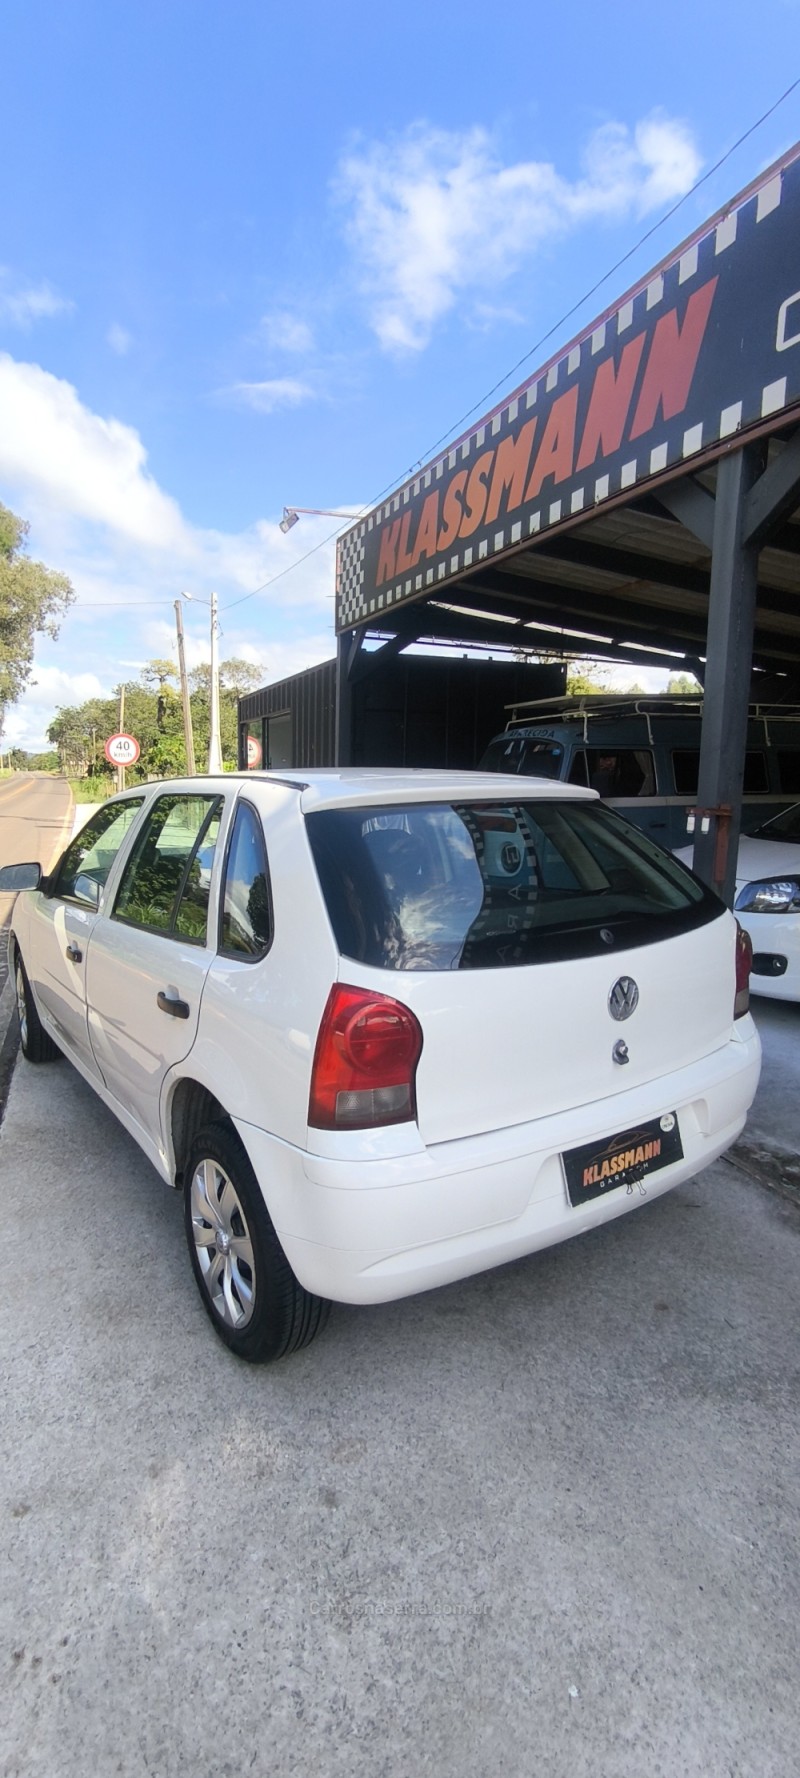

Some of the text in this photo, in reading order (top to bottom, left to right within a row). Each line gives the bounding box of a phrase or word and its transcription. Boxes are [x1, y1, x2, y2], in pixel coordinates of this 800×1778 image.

[376, 275, 719, 587] KLASSMANN
[116, 741, 130, 751] 40
[583, 1139, 661, 1187] KLASSMANN
